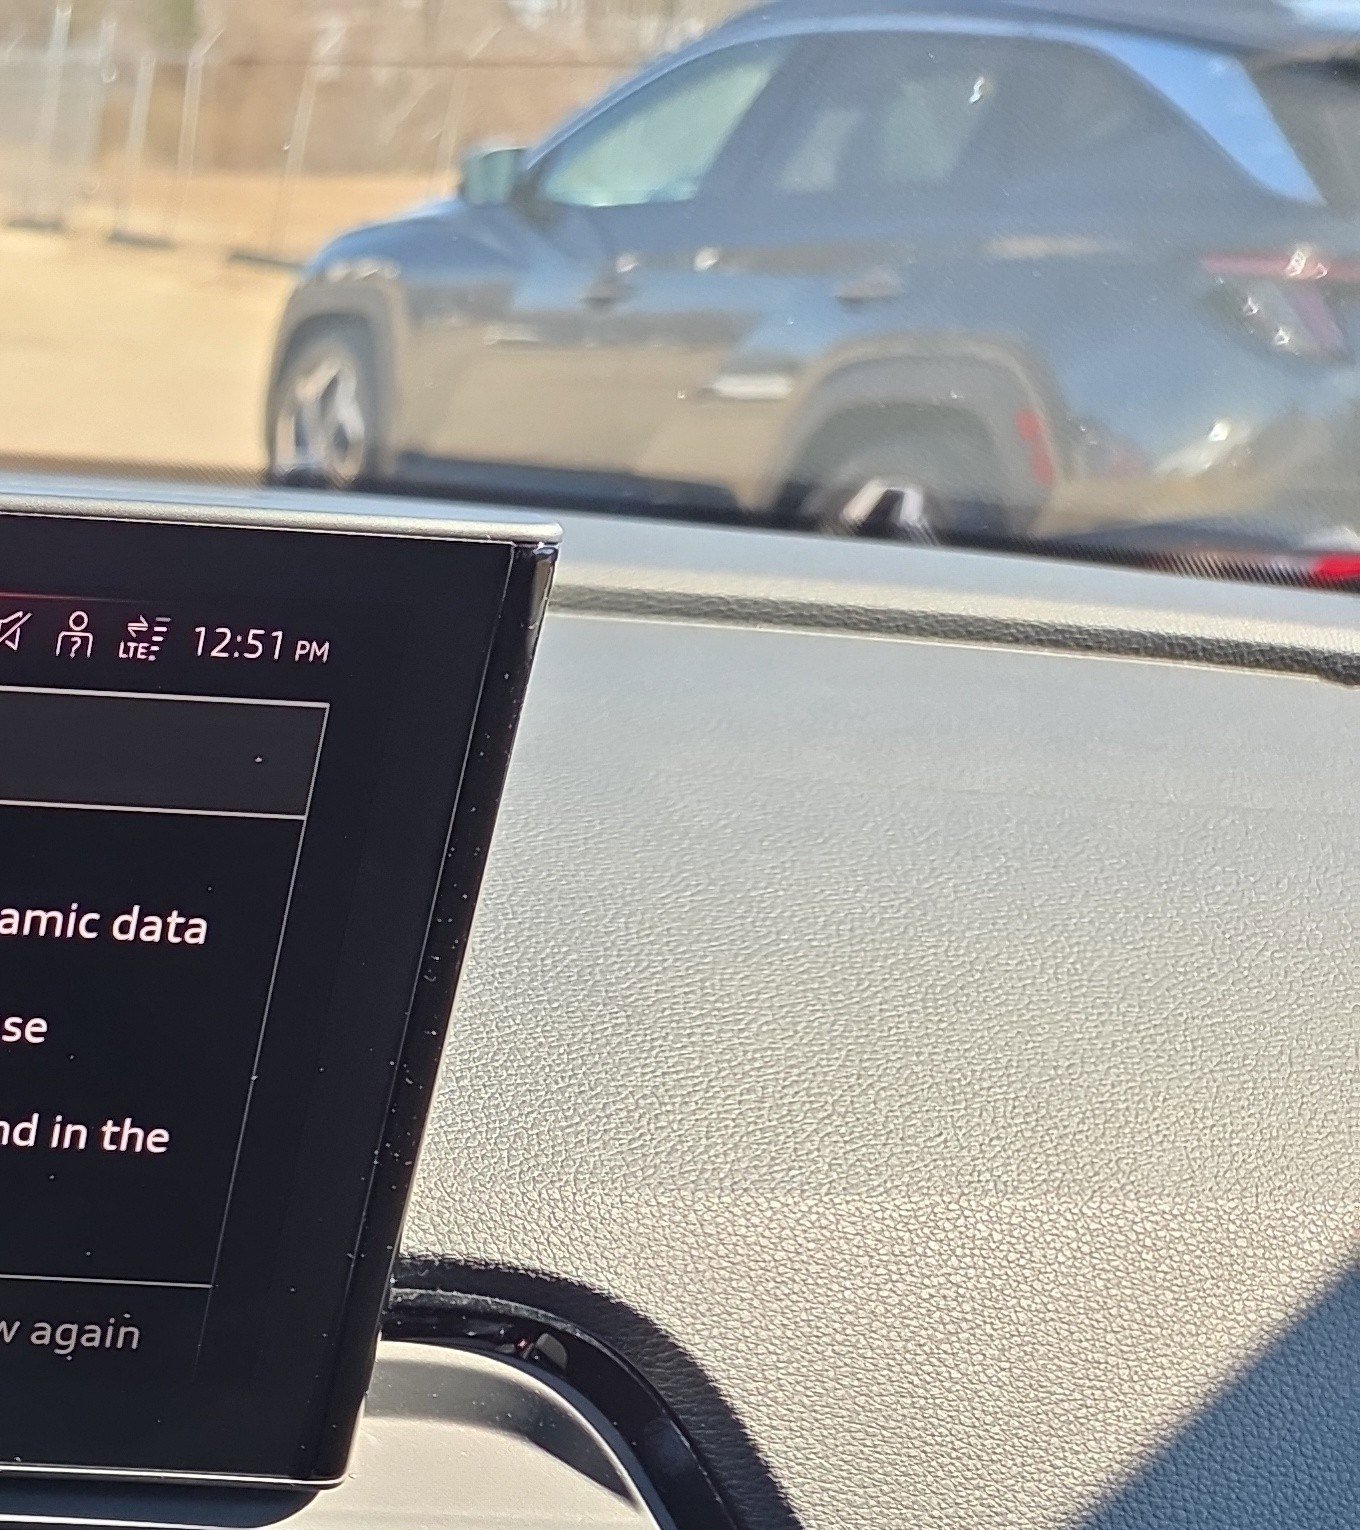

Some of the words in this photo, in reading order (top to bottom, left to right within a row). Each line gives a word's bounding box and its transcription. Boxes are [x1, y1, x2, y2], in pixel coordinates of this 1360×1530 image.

[194, 626, 283, 660] 12:51
[294, 640, 330, 663] PM
[112, 904, 208, 945] data
[50, 1114, 88, 1150] in
[101, 1117, 170, 1153] the
[30, 1318, 140, 1355] again
